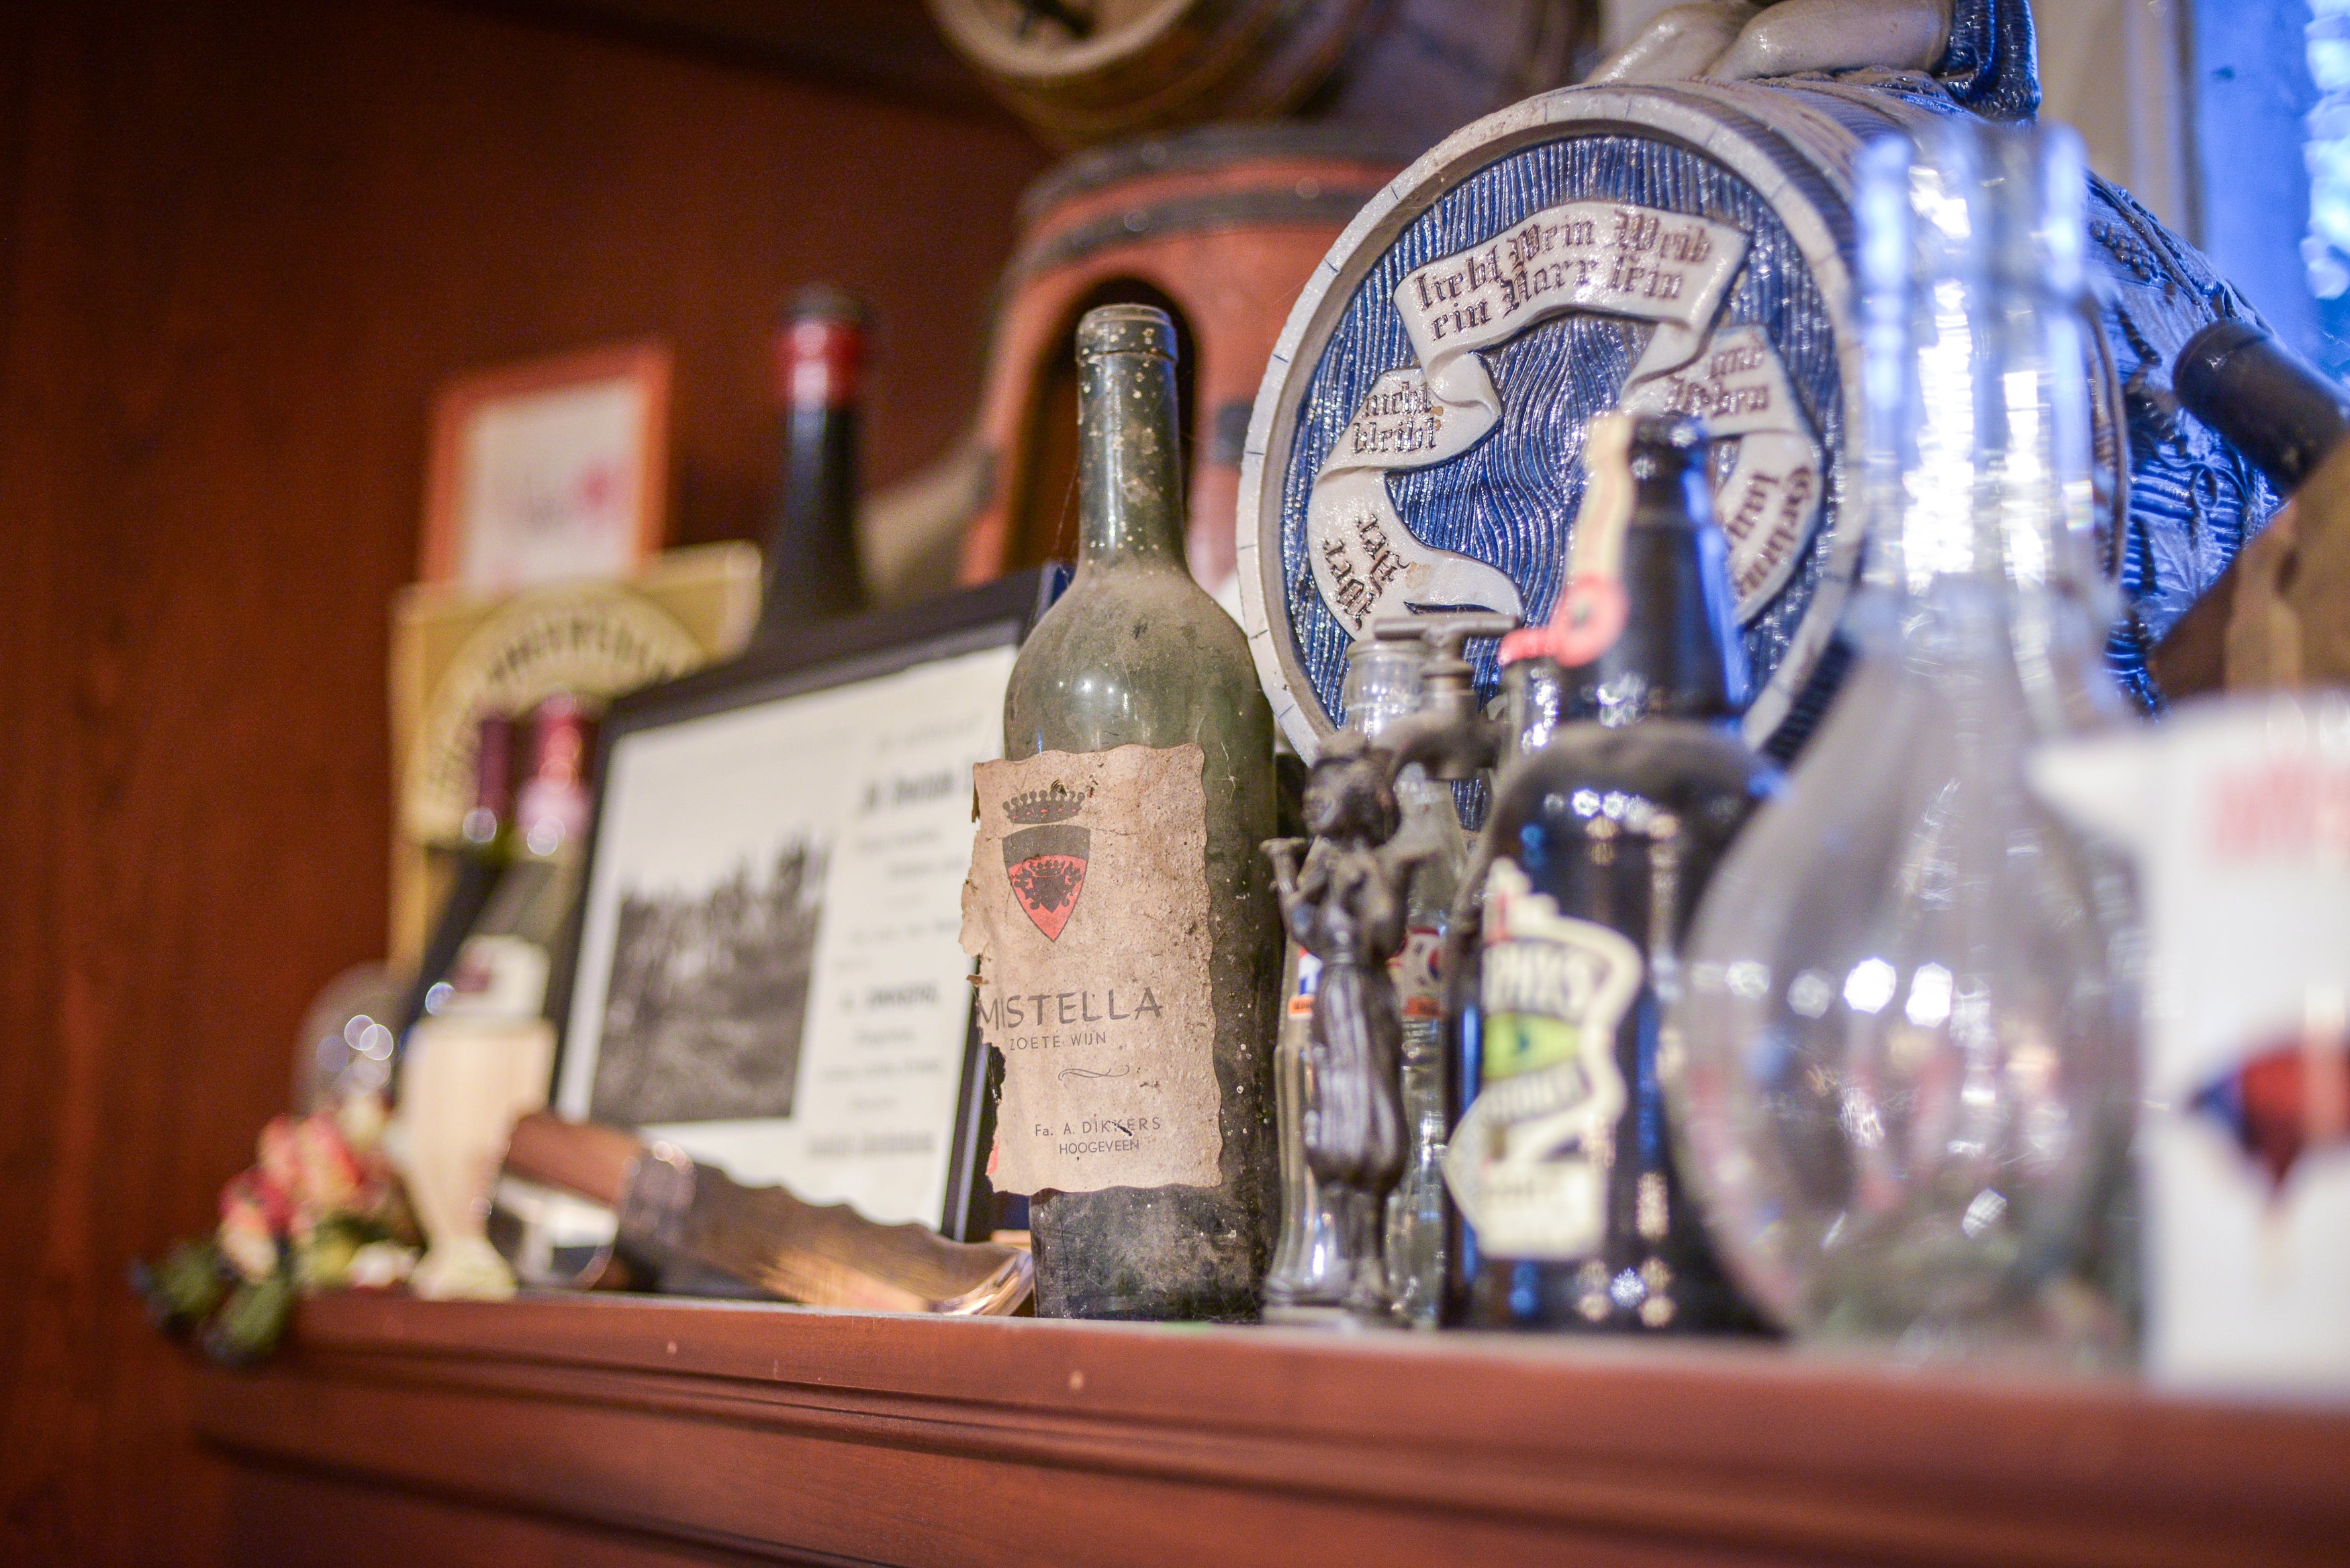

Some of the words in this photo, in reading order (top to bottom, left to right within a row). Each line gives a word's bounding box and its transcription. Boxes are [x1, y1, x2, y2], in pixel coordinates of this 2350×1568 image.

[1413, 244, 1505, 311] liebt
[1431, 301, 1491, 341] ein
[978, 986, 1164, 1030] MISTELLA
[1010, 1036, 1060, 1050] ZOETE
[1071, 1031, 1107, 1046] WIJN
[1063, 1122, 1075, 1135] A.
[1082, 1117, 1161, 1134] DIKKERS
[1059, 1139, 1139, 1155] HOOGEVEEN
